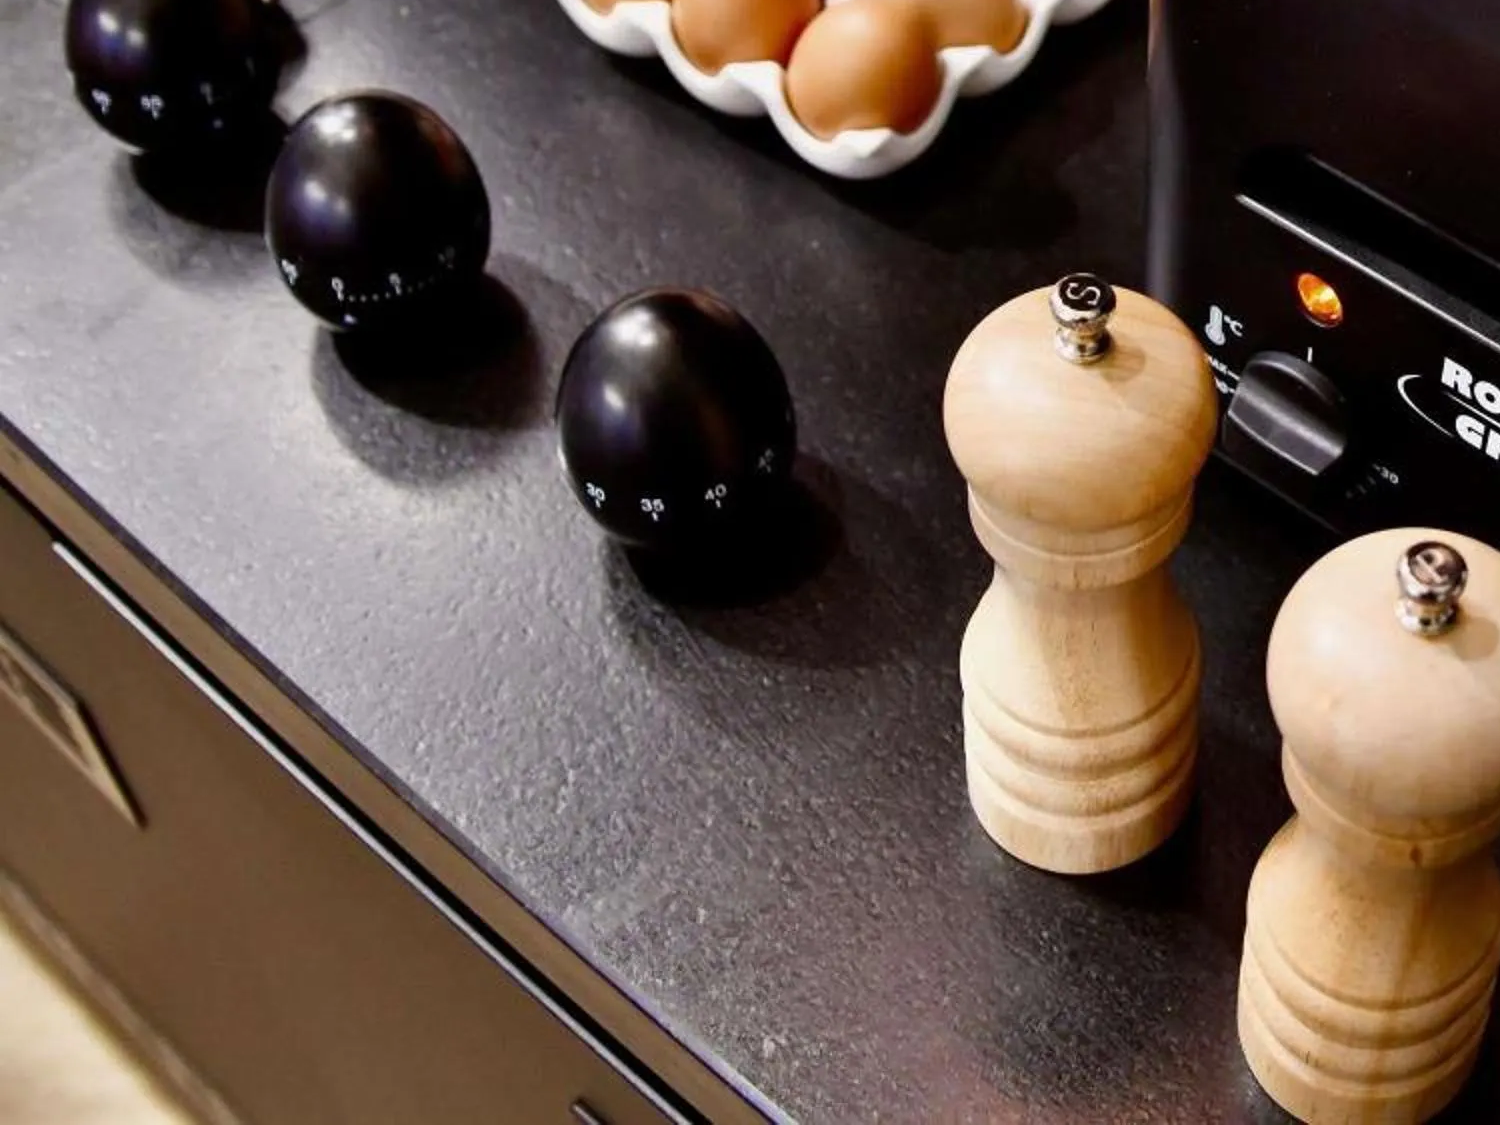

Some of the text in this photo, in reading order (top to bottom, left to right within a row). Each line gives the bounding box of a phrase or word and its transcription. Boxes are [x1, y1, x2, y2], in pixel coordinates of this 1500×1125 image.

[1066, 282, 1101, 305] S
[640, 498, 664, 512] 35
[705, 483, 727, 500] 40
